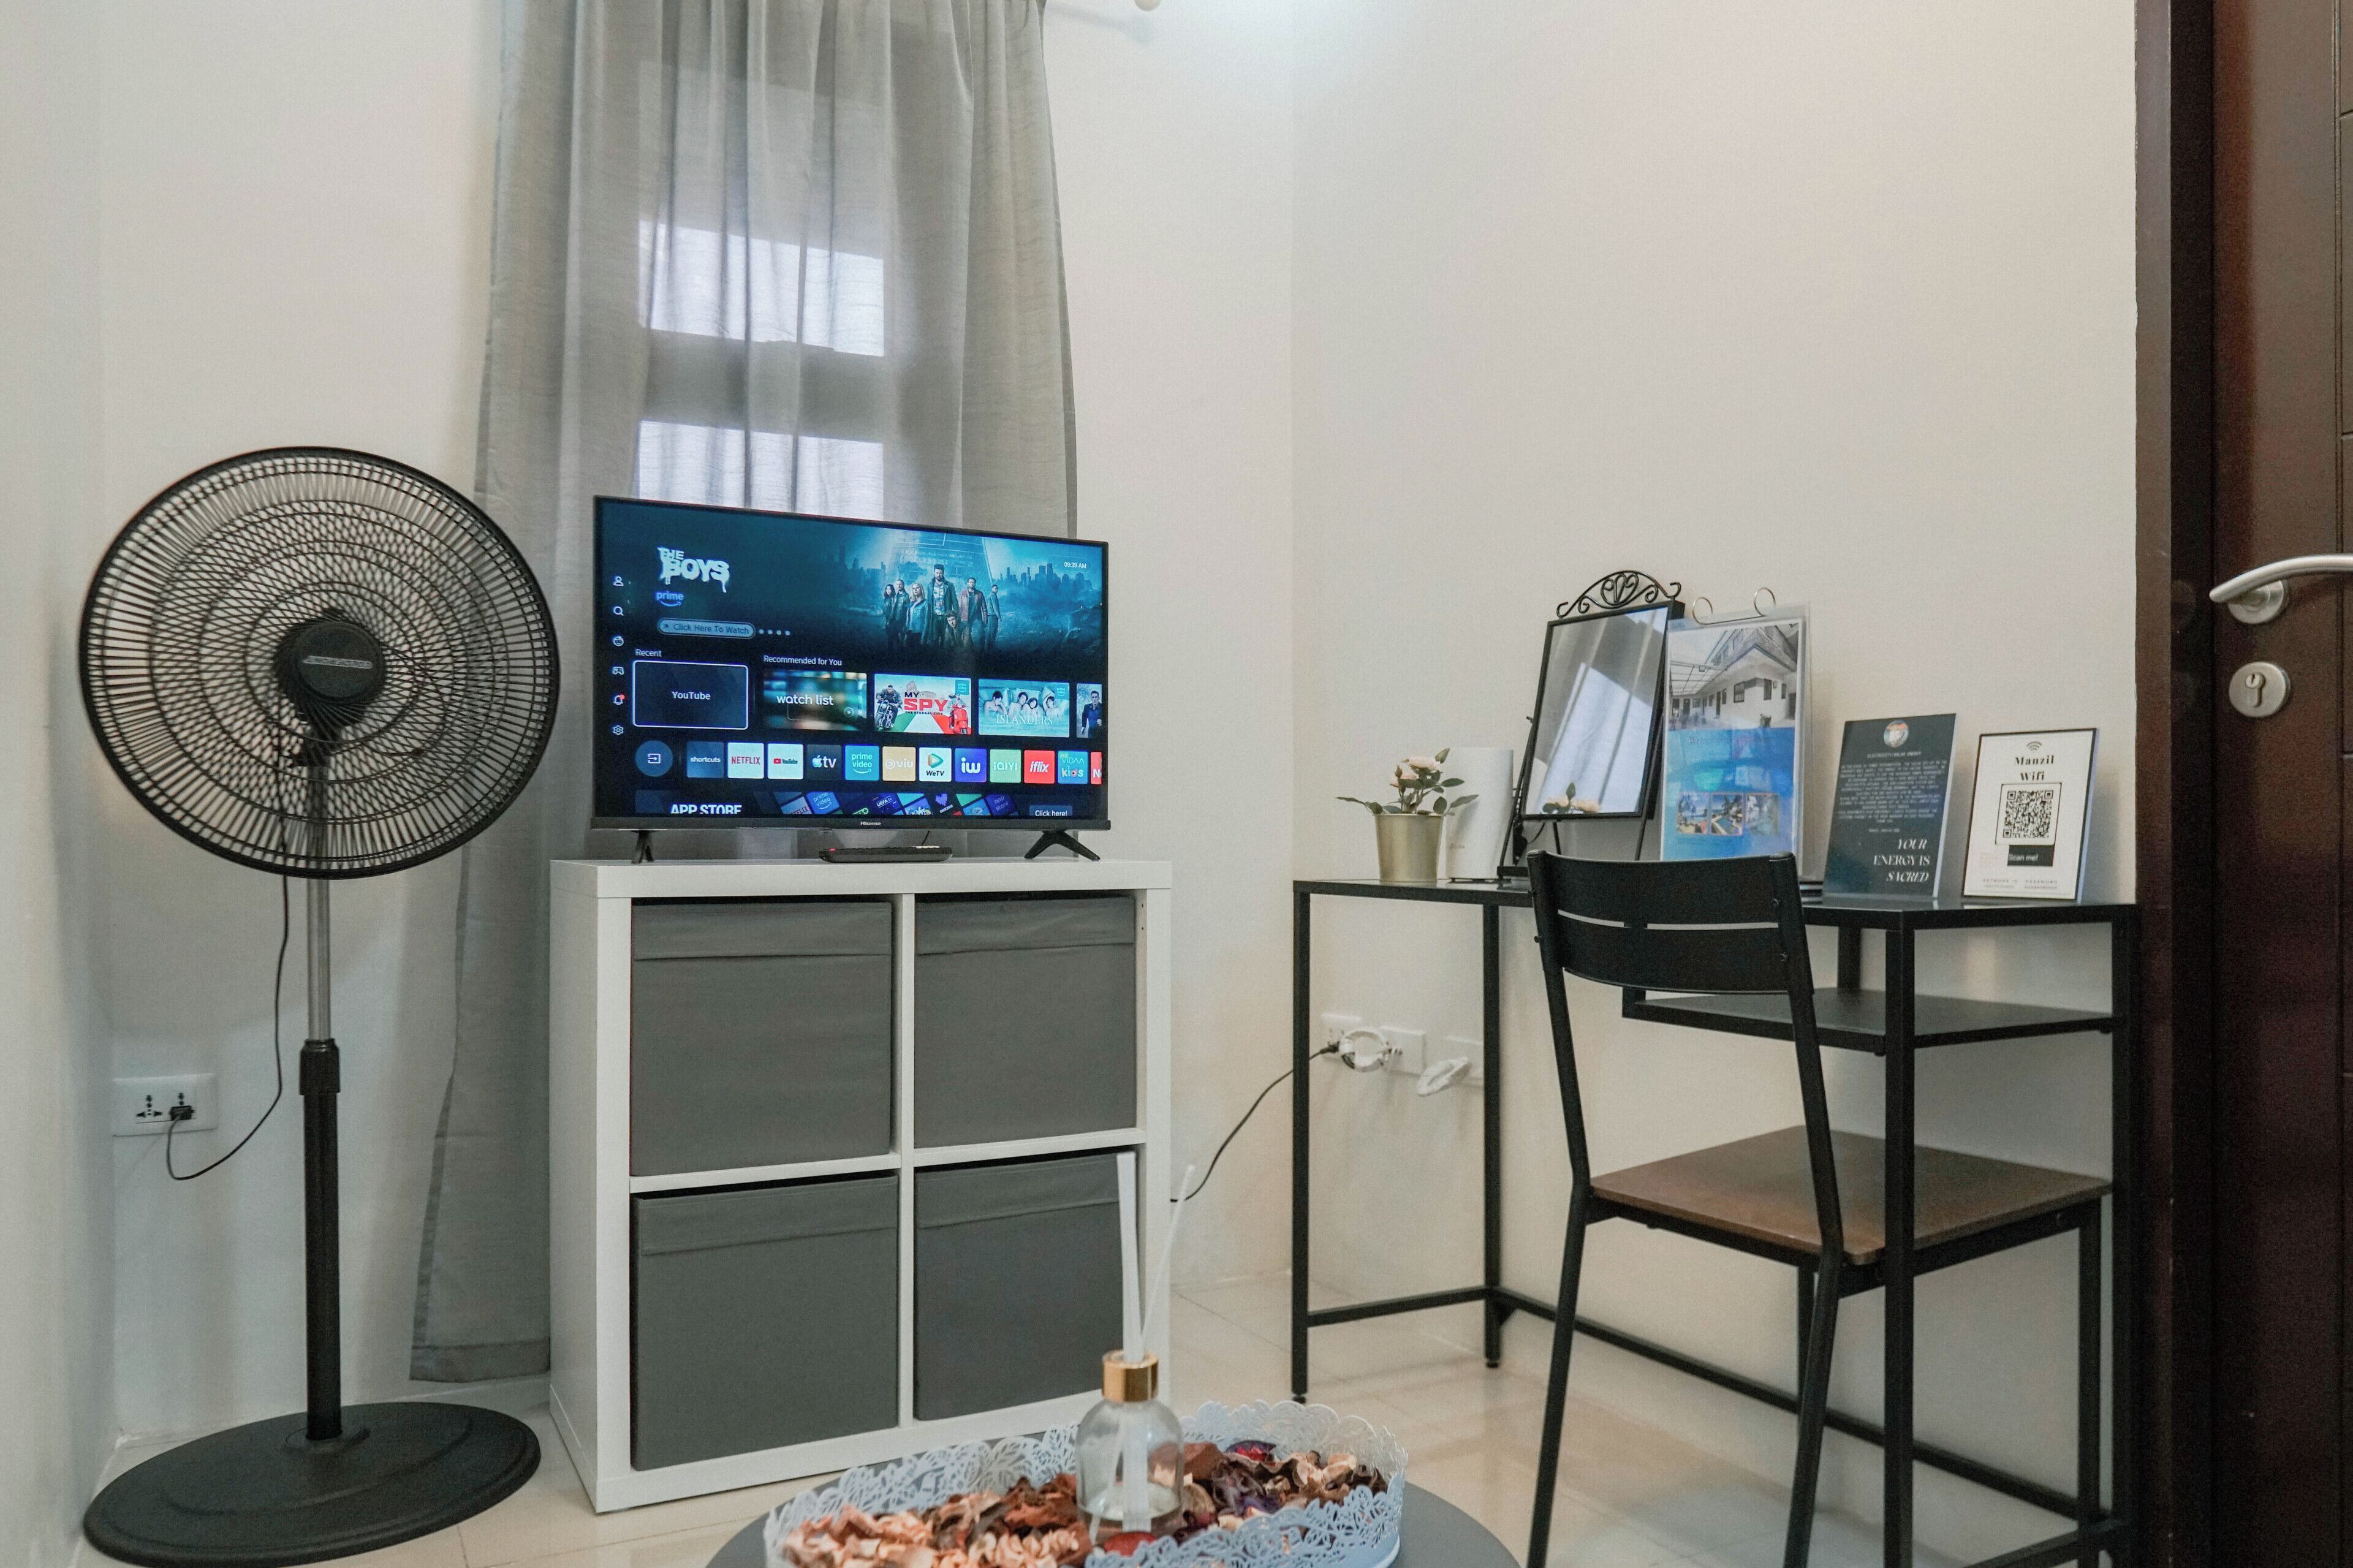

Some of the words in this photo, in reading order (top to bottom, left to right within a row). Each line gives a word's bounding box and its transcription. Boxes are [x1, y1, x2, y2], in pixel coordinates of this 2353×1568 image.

[657, 547, 684, 560] THE
[659, 558, 730, 593] BOYS
[656, 591, 684, 601] prime
[674, 623, 692, 631] Click
[726, 626, 749, 634] Watch
[635, 649, 662, 657] Recent
[763, 655, 817, 665] Recommended
[828, 657, 843, 666] You
[672, 691, 711, 700] YouTube
[776, 694, 813, 705] watch
[816, 695, 834, 706] list
[904, 698, 949, 711] SPY
[996, 714, 1053, 725] ISLANDERS
[731, 756, 760, 765] NETFLIX
[852, 752, 873, 761] prime
[2014, 755, 2054, 765] Manzil
[822, 757, 837, 768] tv
[895, 759, 914, 768] viu
[993, 762, 1018, 771] iQIYI
[1029, 761, 1050, 773] iflix
[1061, 766, 1084, 778] kids
[2020, 771, 2045, 781] Wifi
[876, 798, 889, 807] UEFA
[995, 801, 1009, 811] store
[670, 804, 697, 814] APP
[699, 804, 742, 814] STORE
[1898, 839, 1927, 850] YOUR
[1873, 855, 1915, 866] ENERGY
[1919, 855, 1930, 866] IS
[1885, 871, 1929, 883] SACRED
